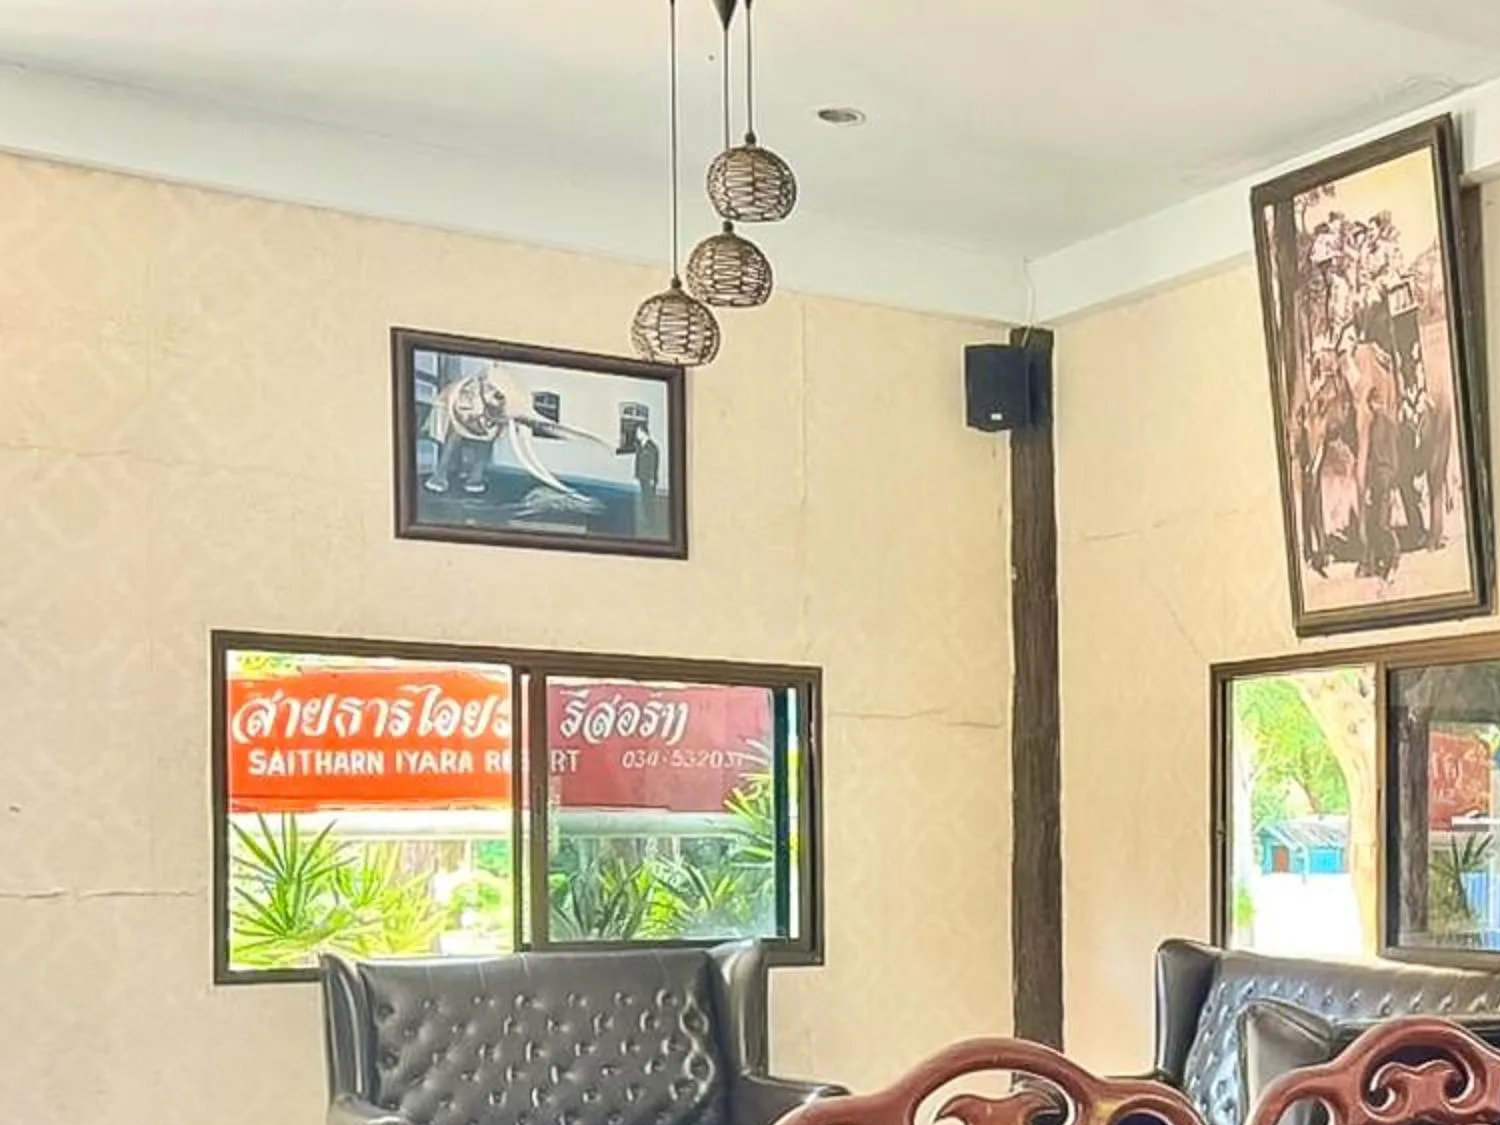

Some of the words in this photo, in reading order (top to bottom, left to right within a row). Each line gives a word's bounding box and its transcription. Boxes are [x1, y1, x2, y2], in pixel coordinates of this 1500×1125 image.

[232, 684, 512, 744] สายธารไอยร
[248, 749, 384, 776] SAITHARN
[396, 750, 473, 775] IYARA
